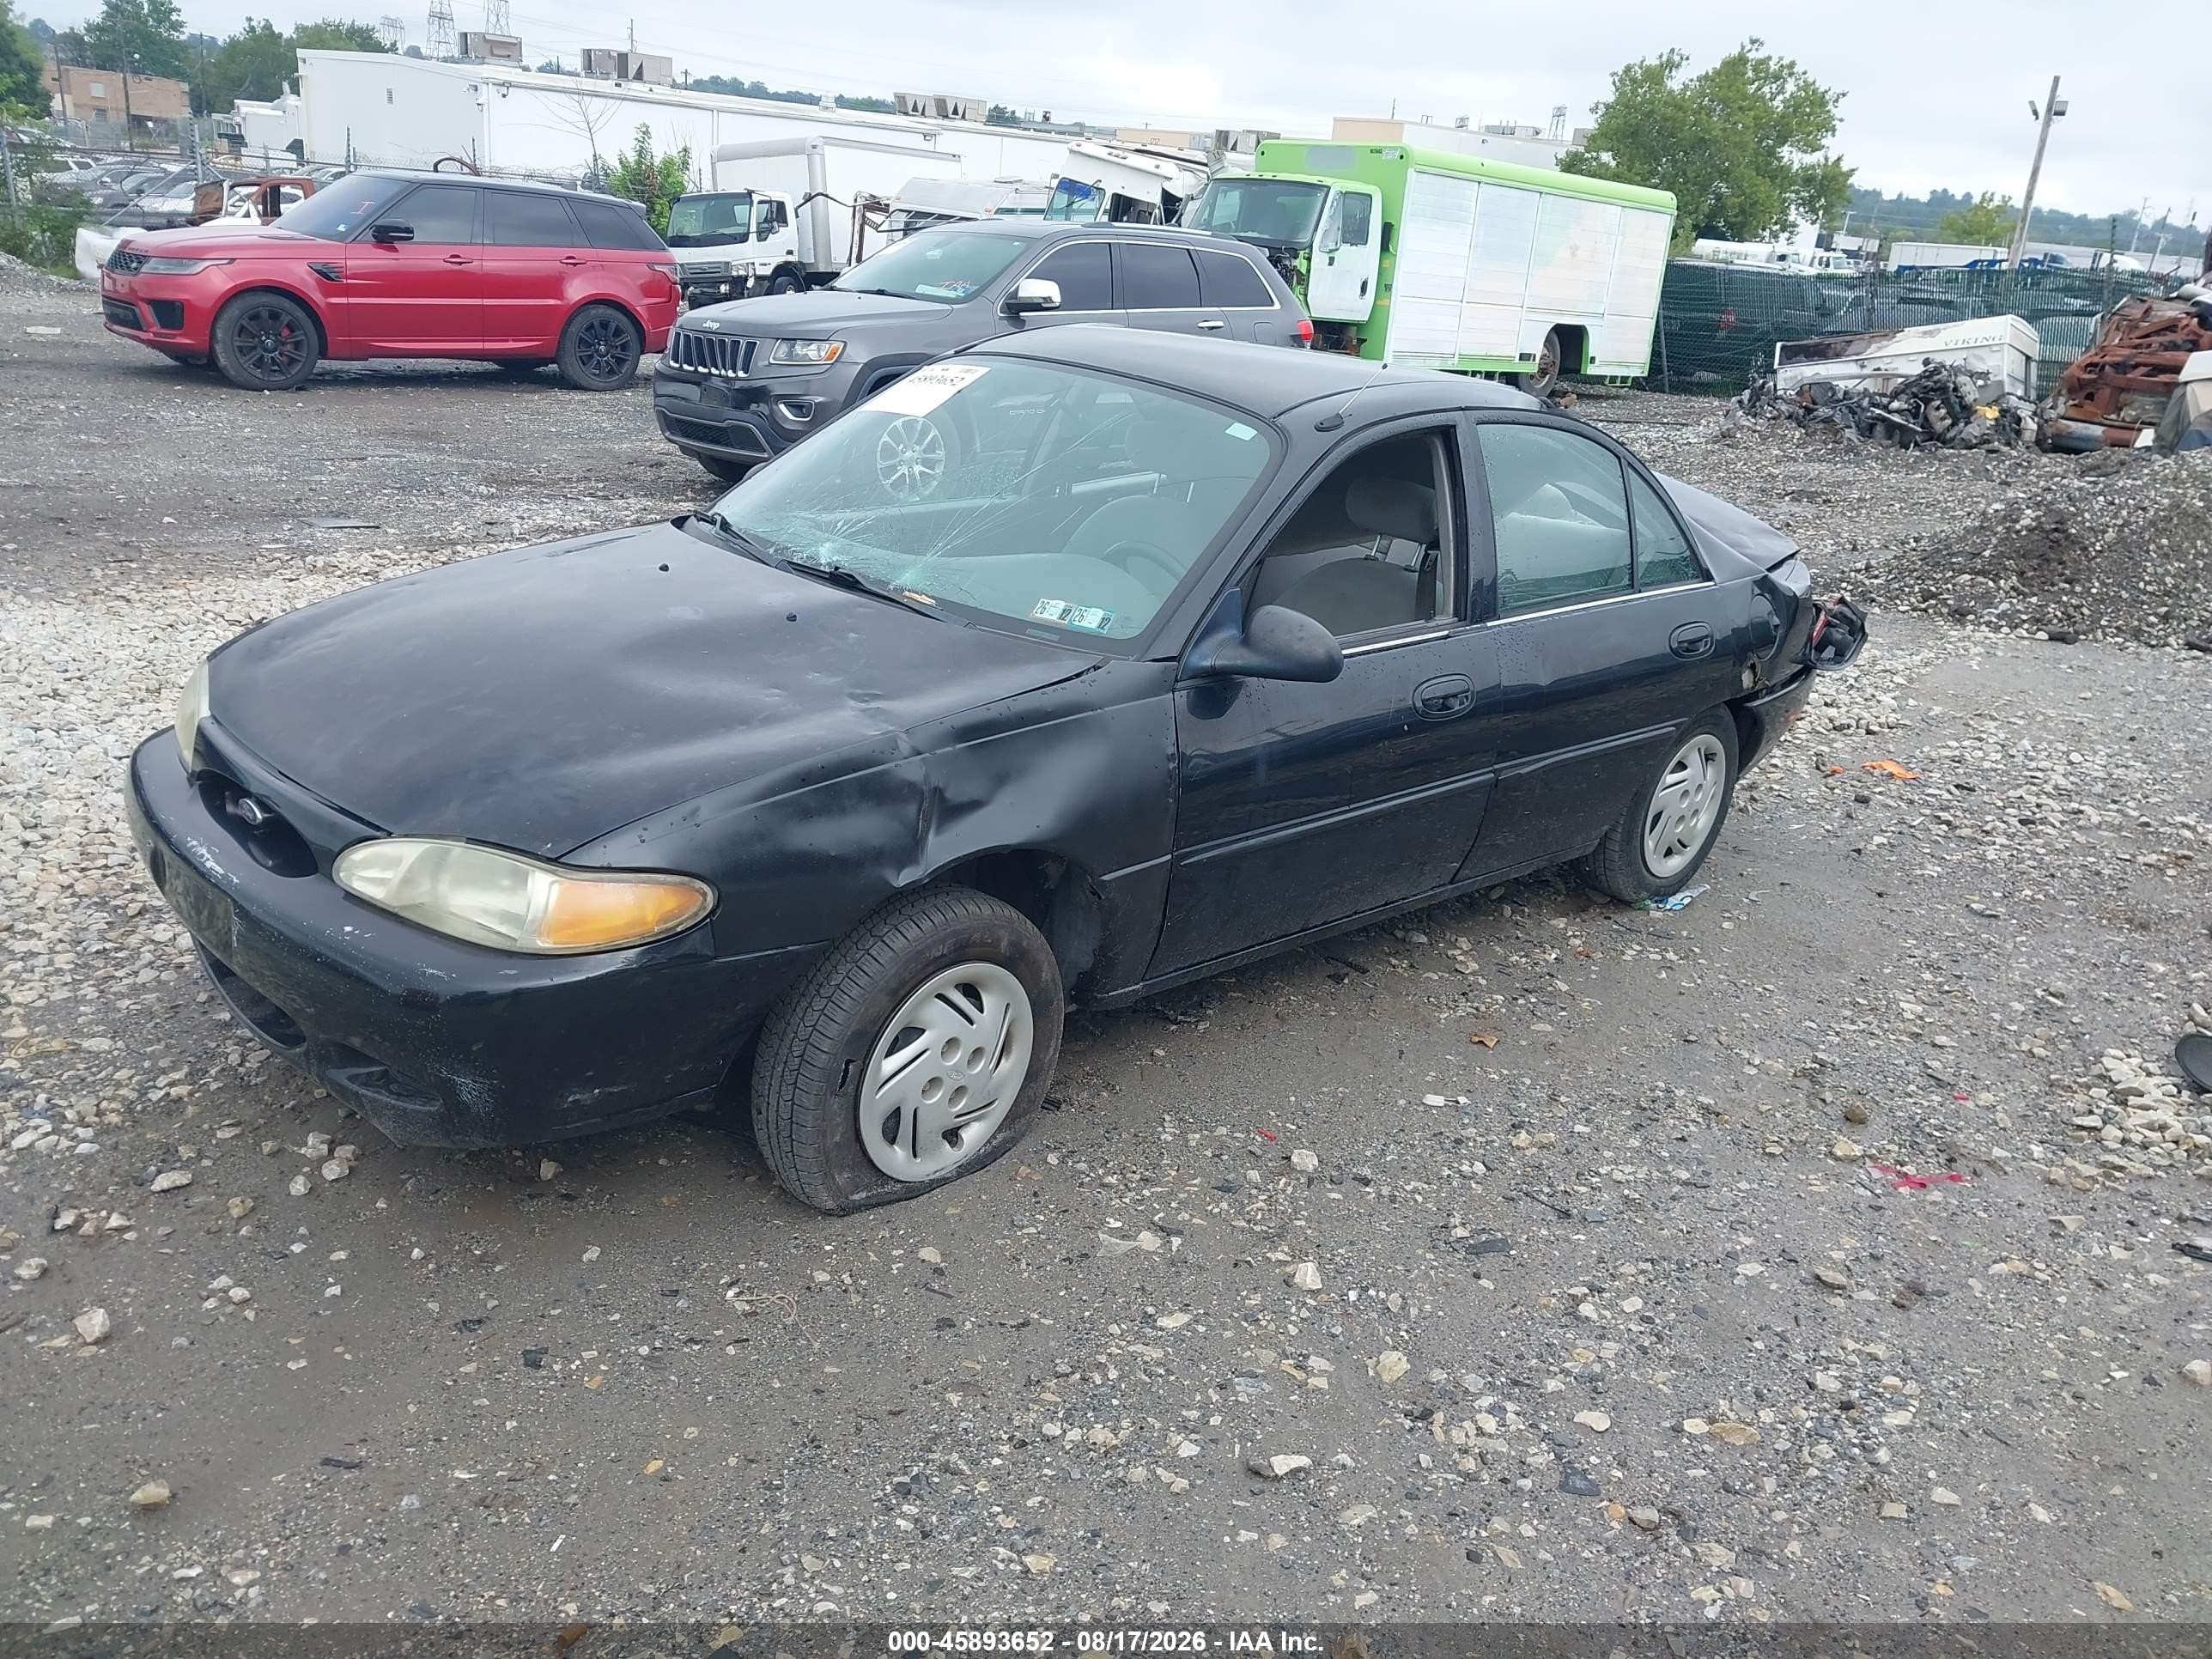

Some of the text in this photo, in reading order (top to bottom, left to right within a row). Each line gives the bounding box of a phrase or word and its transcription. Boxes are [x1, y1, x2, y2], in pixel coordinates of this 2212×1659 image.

[702, 319, 720, 331] Jeep
[1943, 334, 2005, 347] VIKING
[1035, 600, 1073, 622] 26 12
[1073, 608, 1112, 630] 26 12
